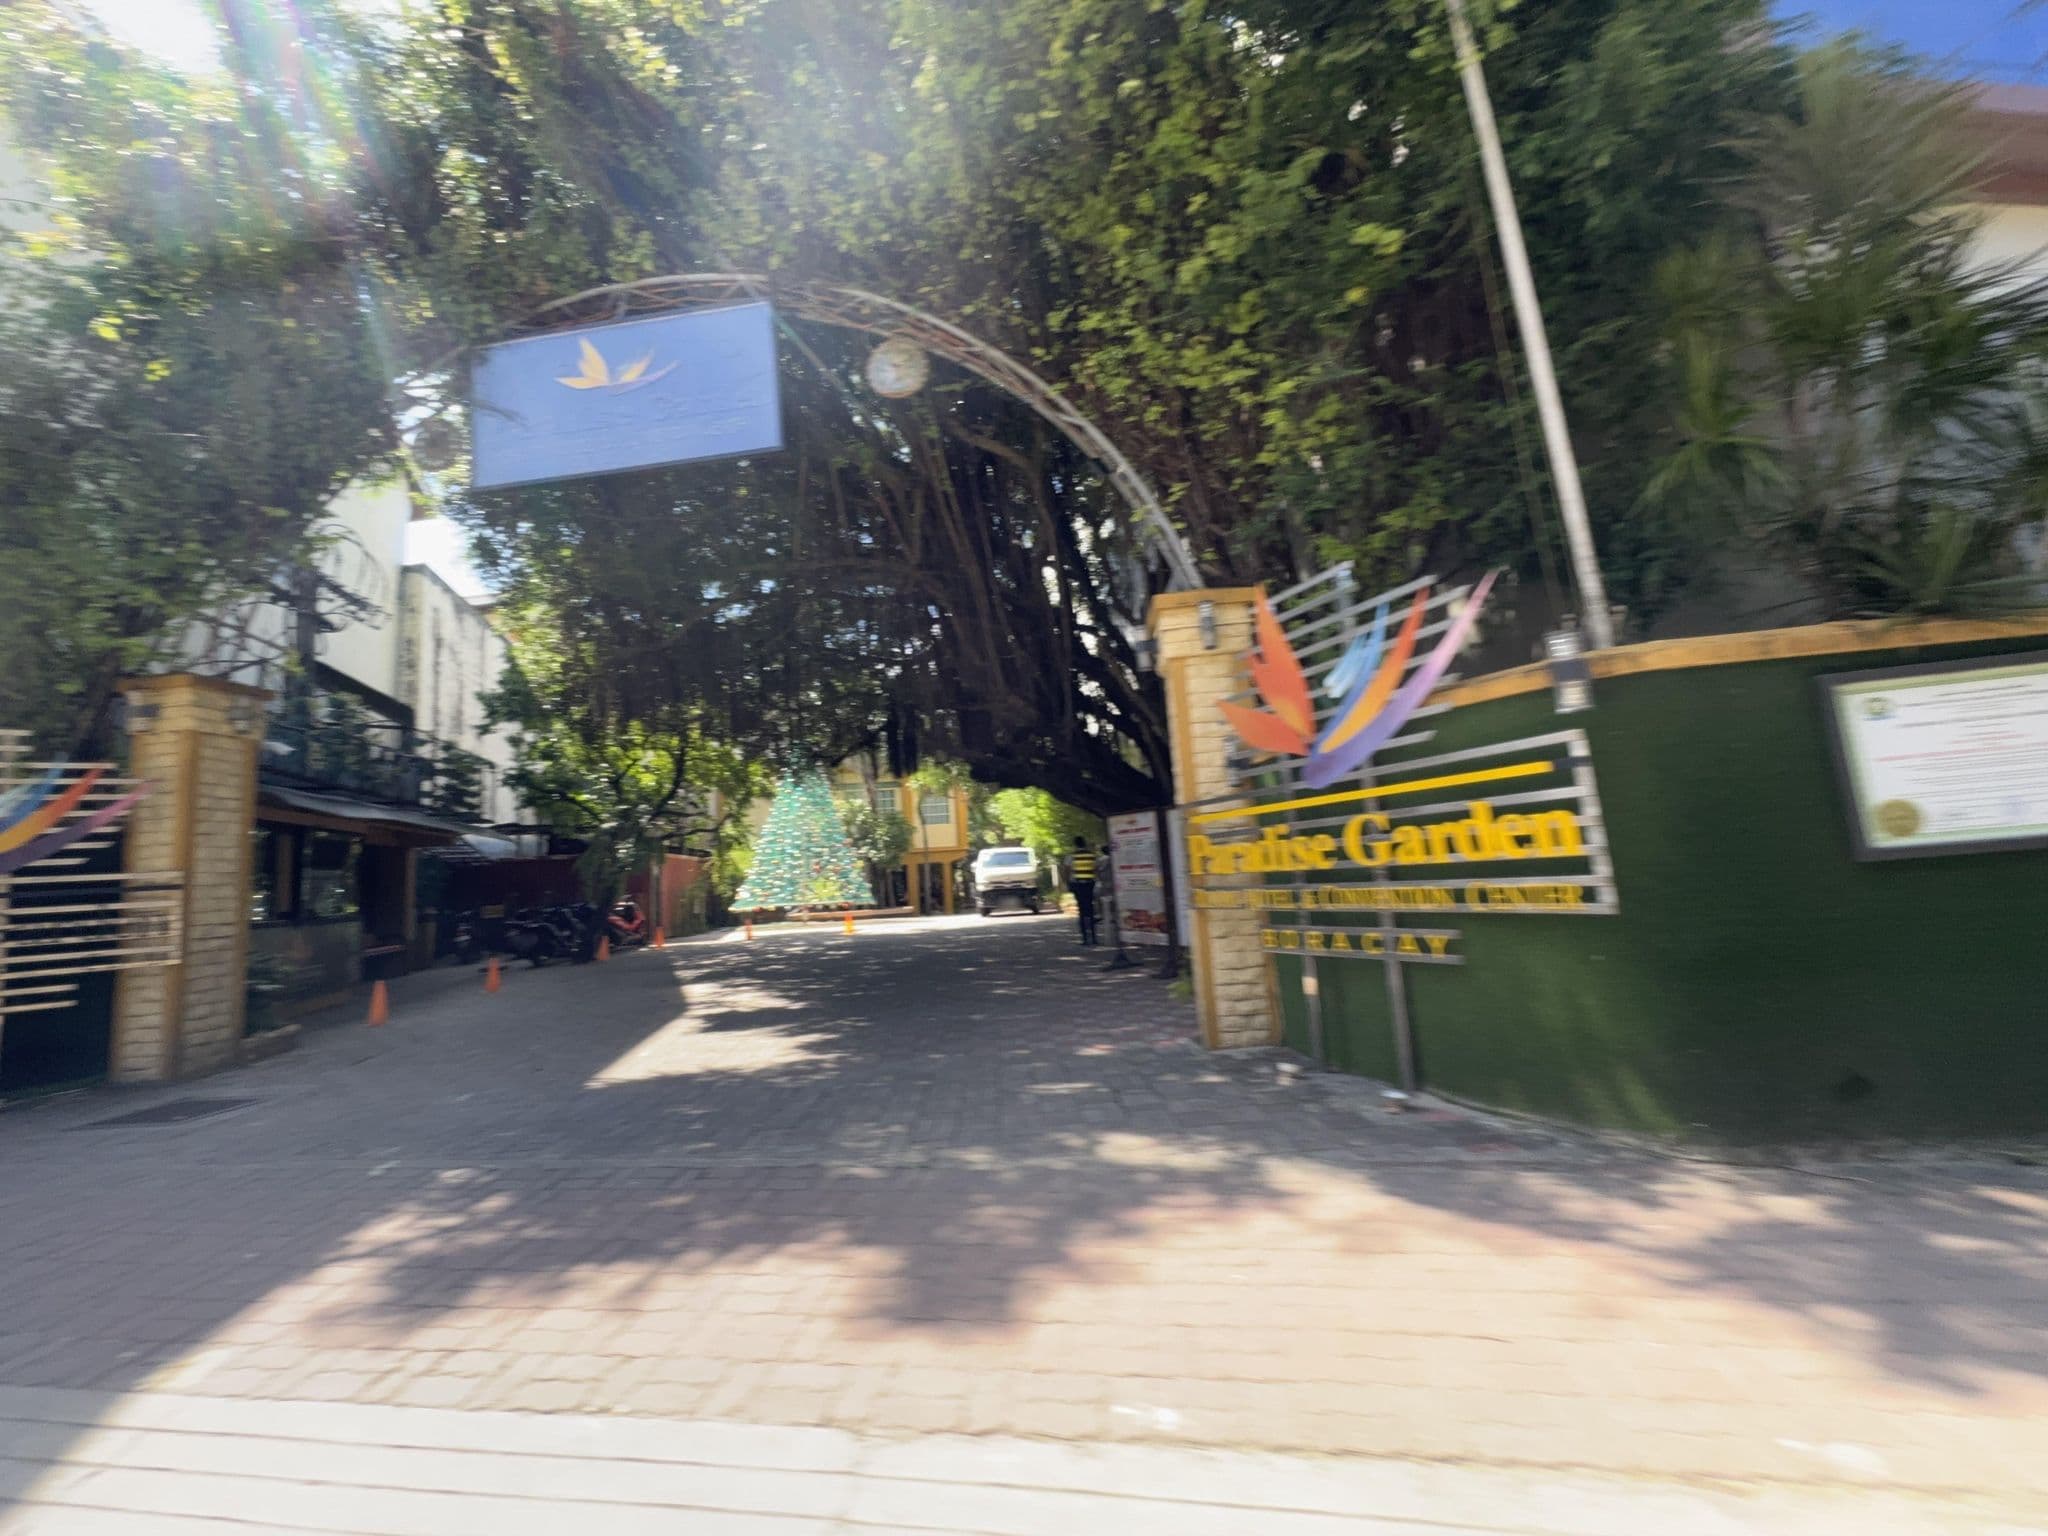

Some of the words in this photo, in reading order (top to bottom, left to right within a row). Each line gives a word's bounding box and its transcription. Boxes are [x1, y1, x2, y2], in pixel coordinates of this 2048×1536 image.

[1188, 824, 1336, 875] Paradise
[1342, 801, 1584, 866] Garden
[1261, 928, 1449, 958] BORACAY
